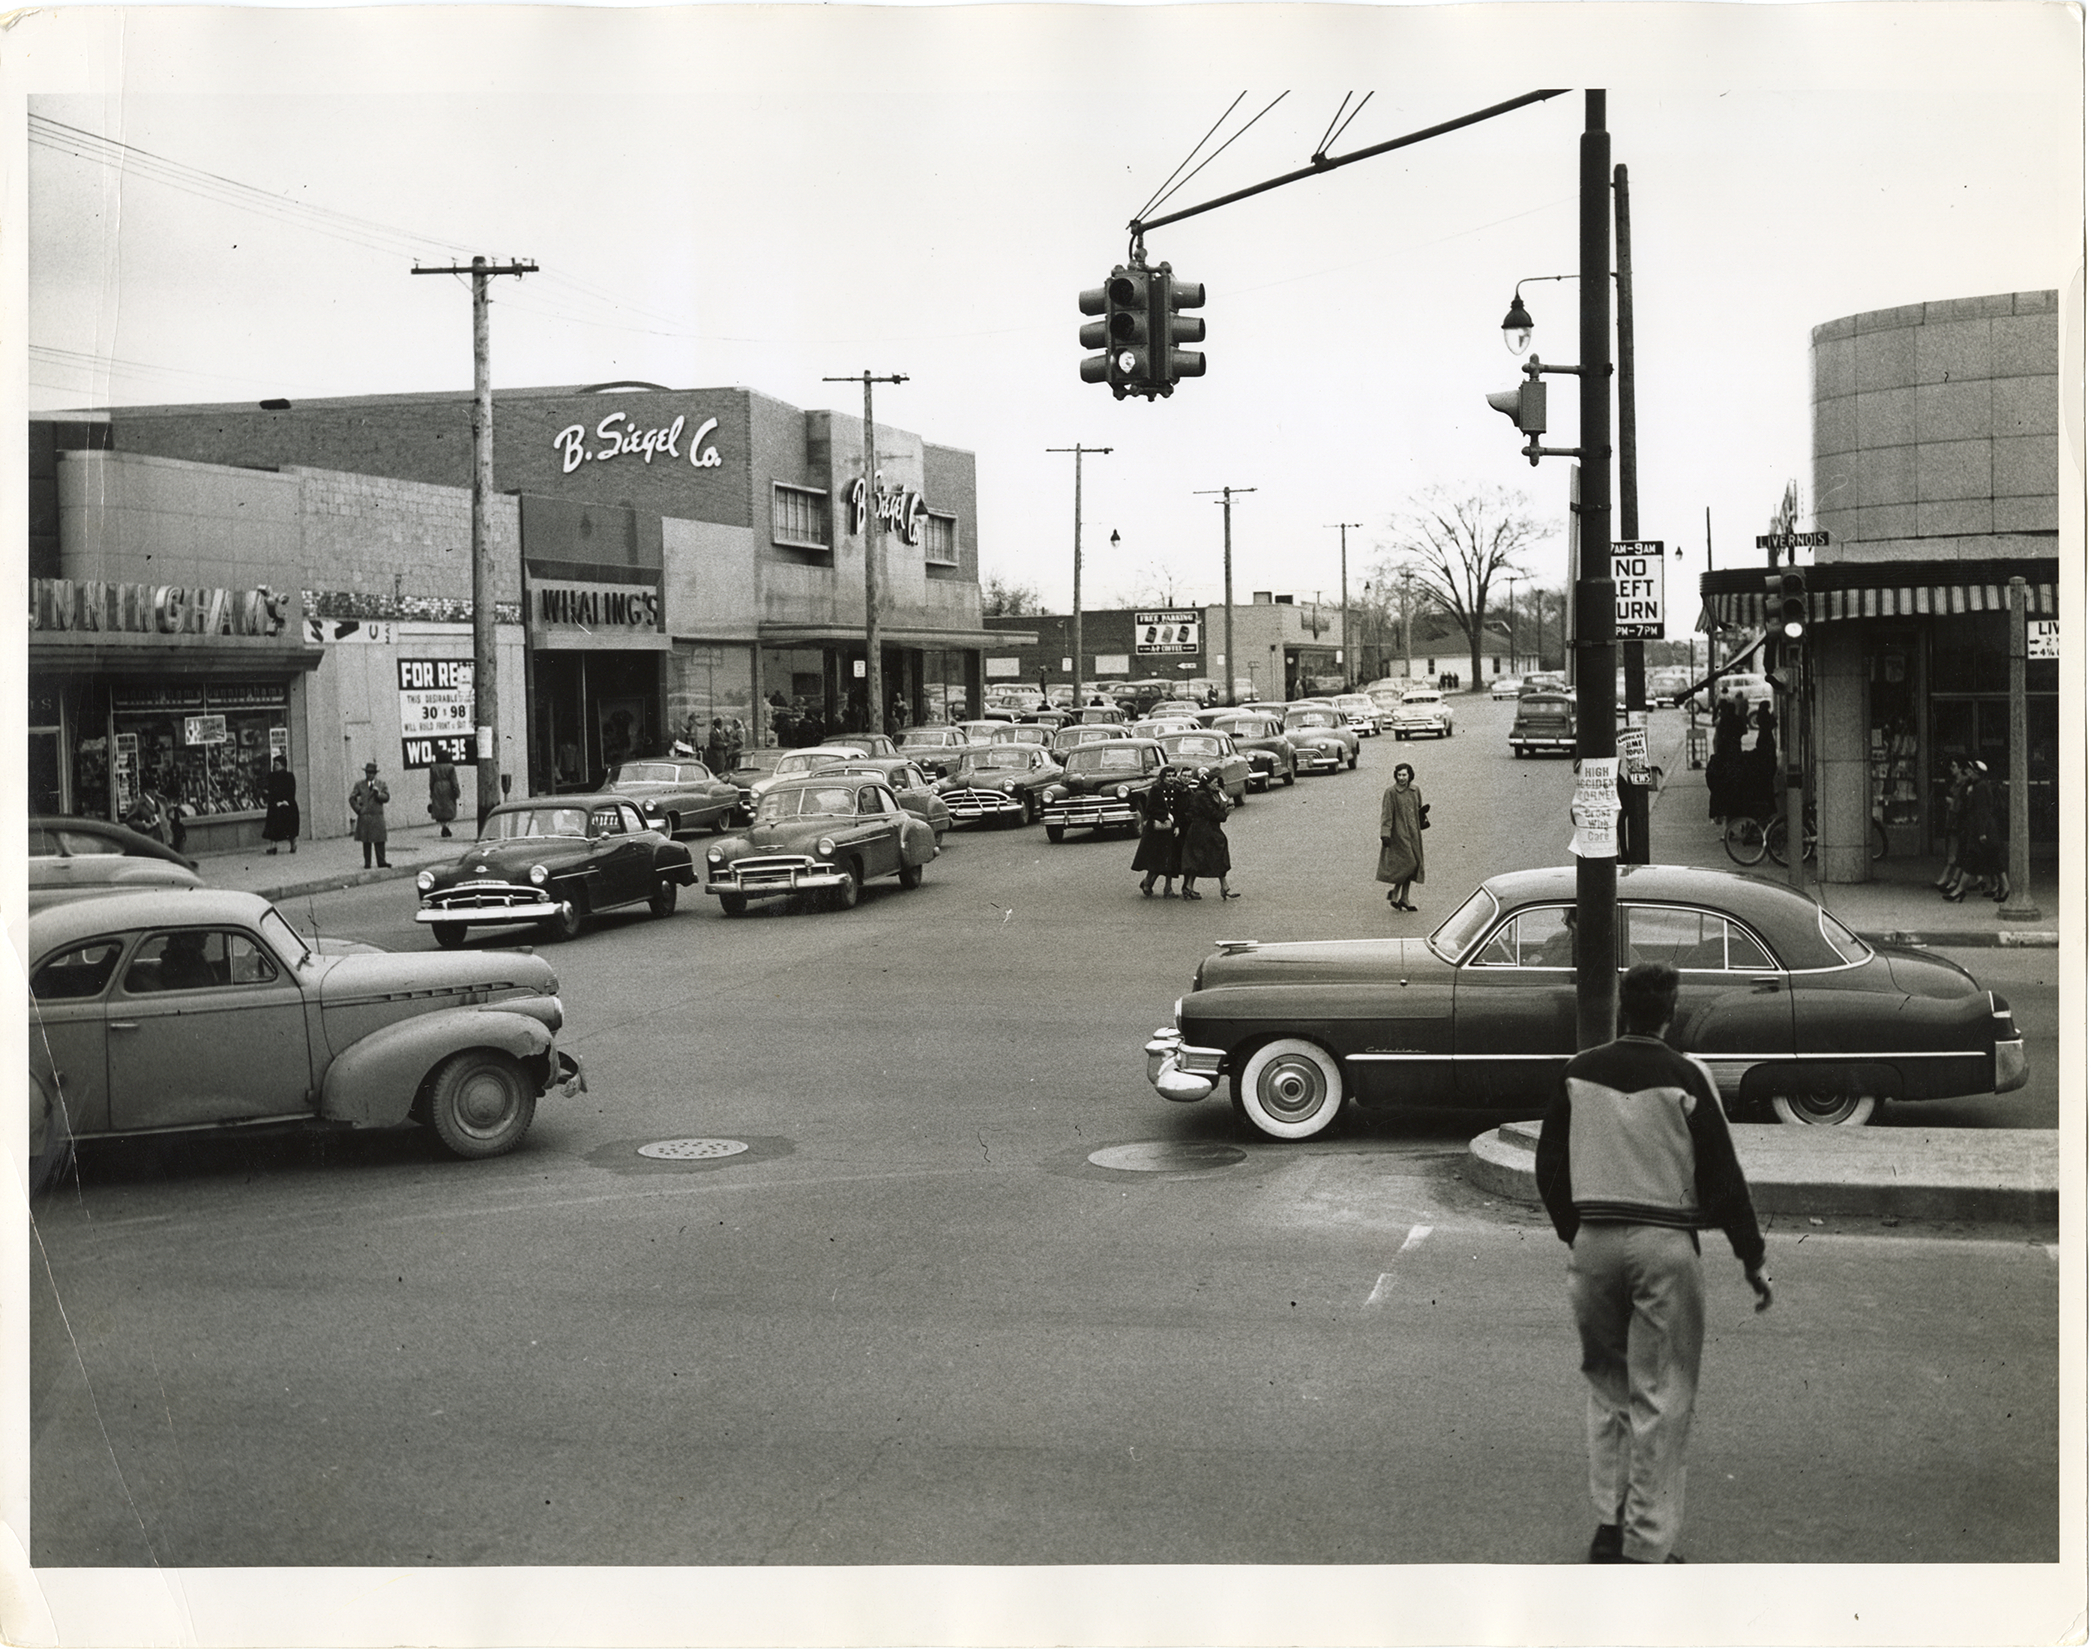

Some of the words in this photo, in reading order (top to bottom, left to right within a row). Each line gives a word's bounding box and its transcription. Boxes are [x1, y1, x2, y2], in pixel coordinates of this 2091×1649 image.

[553, 424, 592, 473] B.
[597, 411, 685, 464] Siegel
[689, 417, 722, 468] Co.
[1757, 533, 1827, 548] LIVERNOIS
[1615, 559, 1646, 577] NO
[1616, 579, 1654, 597] EFT
[1161, 614, 1193, 622] PARKING
[1616, 601, 1657, 619] URN
[401, 662, 434, 688] FOR
[407, 694, 421, 704] THIS
[425, 694, 458, 704] DESIRABLE
[1585, 766, 1609, 777] HIGH
[1588, 831, 1609, 841] Care
